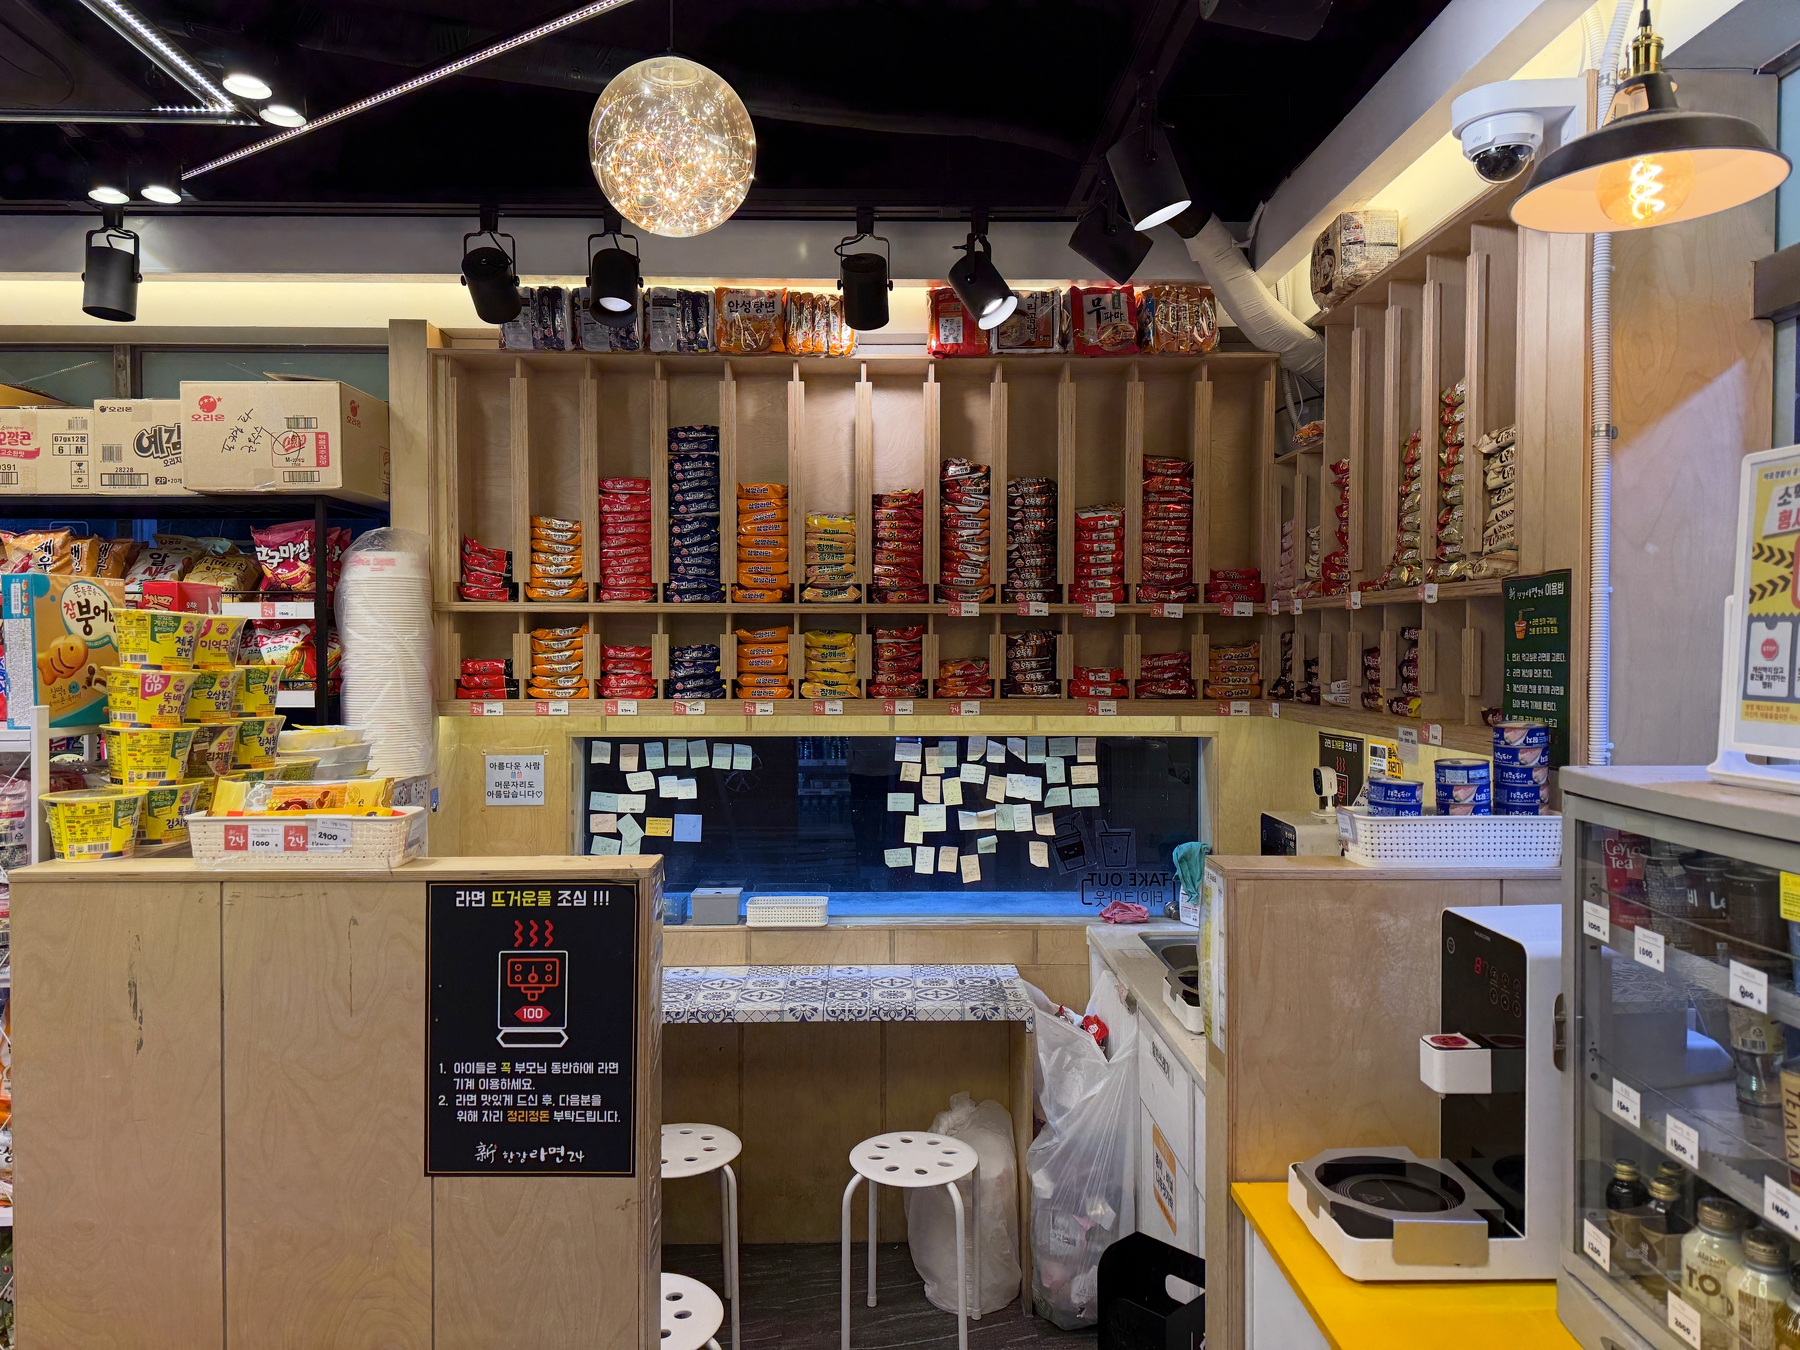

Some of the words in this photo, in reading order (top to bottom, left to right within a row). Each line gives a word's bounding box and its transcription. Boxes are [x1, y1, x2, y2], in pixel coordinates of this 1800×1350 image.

[728, 300, 775, 313] 안성탕면
[191, 414, 225, 422] 오리온
[58, 445, 64, 455] 6
[75, 445, 83, 455] M
[156, 477, 167, 485] 2P
[149, 553, 170, 566] 알
[146, 673, 166, 684] 20%
[145, 683, 162, 693] UP
[819, 689, 846, 697] 참깨라면
[489, 762, 522, 771] 아름다운
[524, 762, 541, 771] 사람
[494, 781, 535, 789] 머문자리도
[228, 836, 246, 847] 24
[318, 831, 338, 841] 2900
[252, 840, 270, 848] 1000
[288, 836, 306, 848] 24
[456, 891, 485, 907] 라면
[491, 890, 551, 907] 뜨거운물
[558, 890, 587, 907] 조심
[593, 890, 609, 906] !!!
[522, 1008, 543, 1019] 100
[439, 1063, 446, 1074] 1.
[453, 1063, 497, 1074] 아이들은
[501, 1062, 511, 1075] 꼭
[515, 1062, 547, 1074] 부모님
[551, 1062, 594, 1075] 동반하에
[598, 1062, 619, 1075] 라면
[453, 1078, 475, 1091] 기계
[479, 1078, 535, 1091] 이용하세요.
[439, 1095, 448, 1106] 2.
[455, 1094, 477, 1107] 라면
[481, 1094, 513, 1107] 맛있게
[517, 1094, 538, 1106] 드신
[542, 1094, 555, 1108] 후,
[559, 1094, 602, 1107] 다음분을
[457, 1110, 478, 1123] 위해
[482, 1110, 503, 1123] 자리
[507, 1110, 550, 1123] 정리정돈
[553, 1110, 621, 1123] 부탁드립니다.
[1673, 1316, 1692, 1336] 2000
